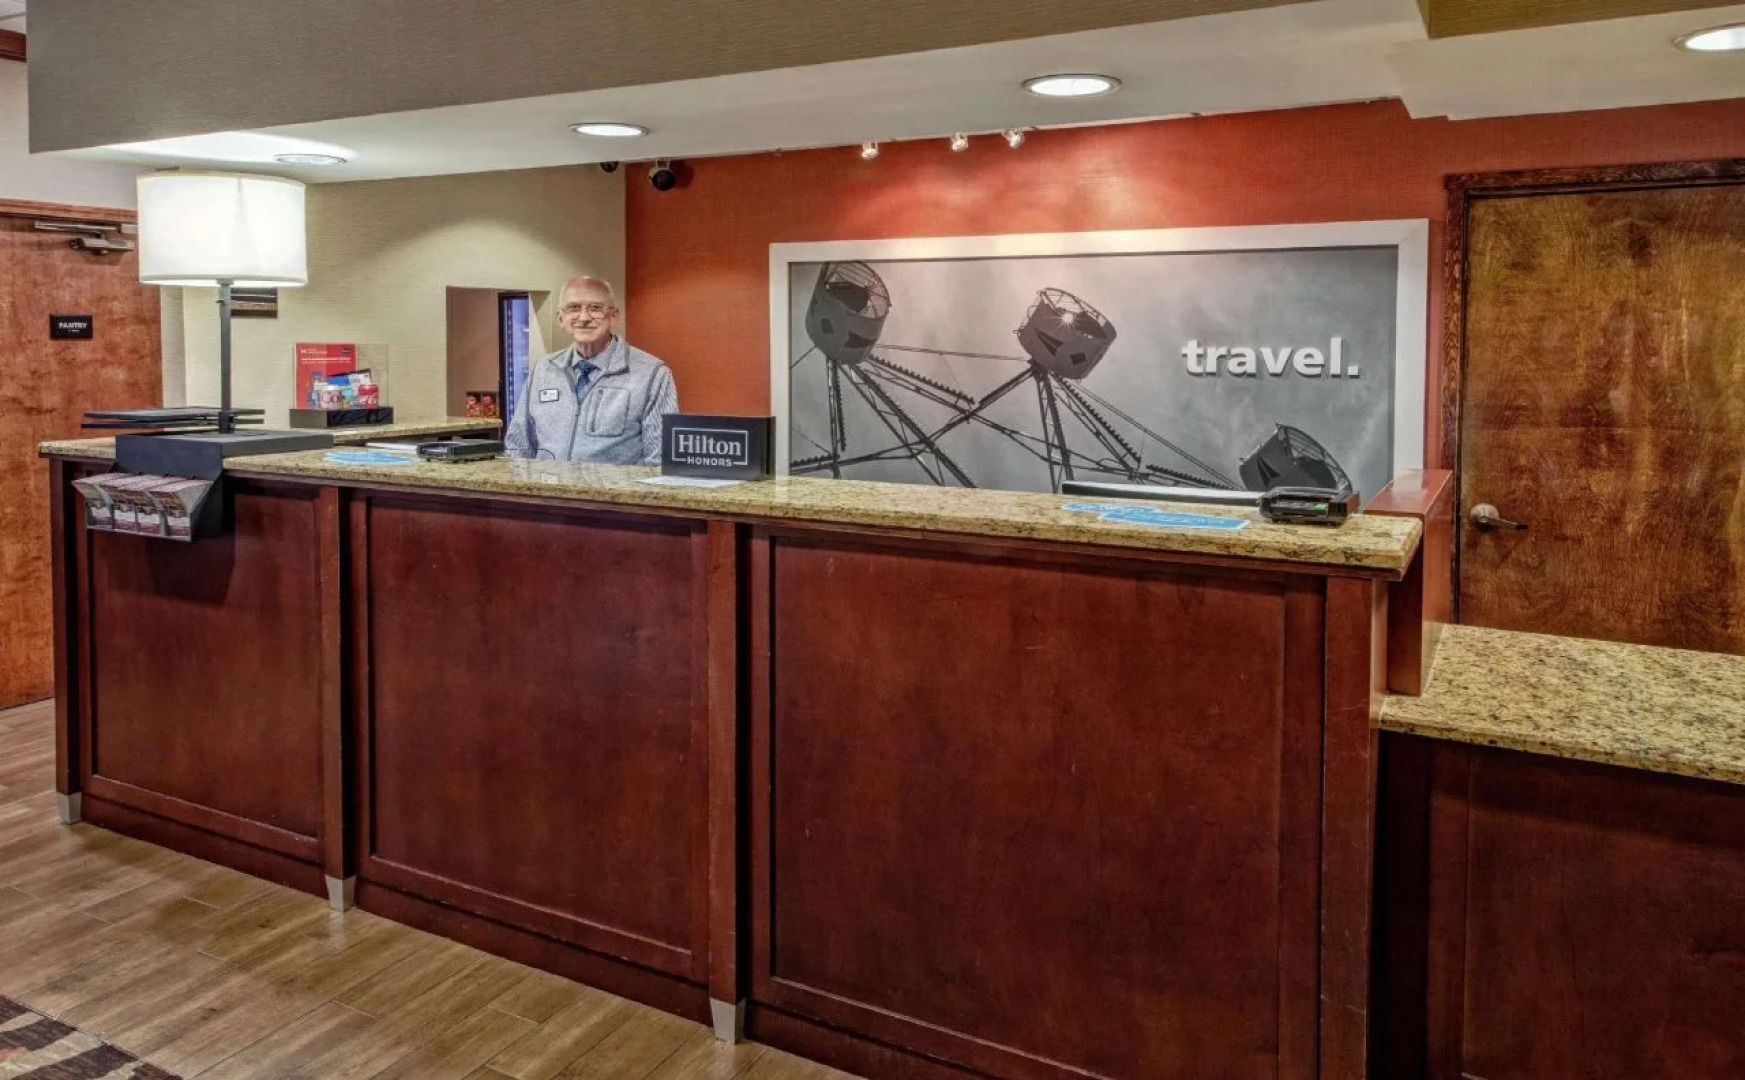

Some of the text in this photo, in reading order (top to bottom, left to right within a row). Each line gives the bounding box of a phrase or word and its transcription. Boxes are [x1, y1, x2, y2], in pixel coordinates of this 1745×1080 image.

[1181, 336, 1360, 378] travel.
[678, 434, 741, 456] Hilton
[686, 456, 732, 467] HONORS
